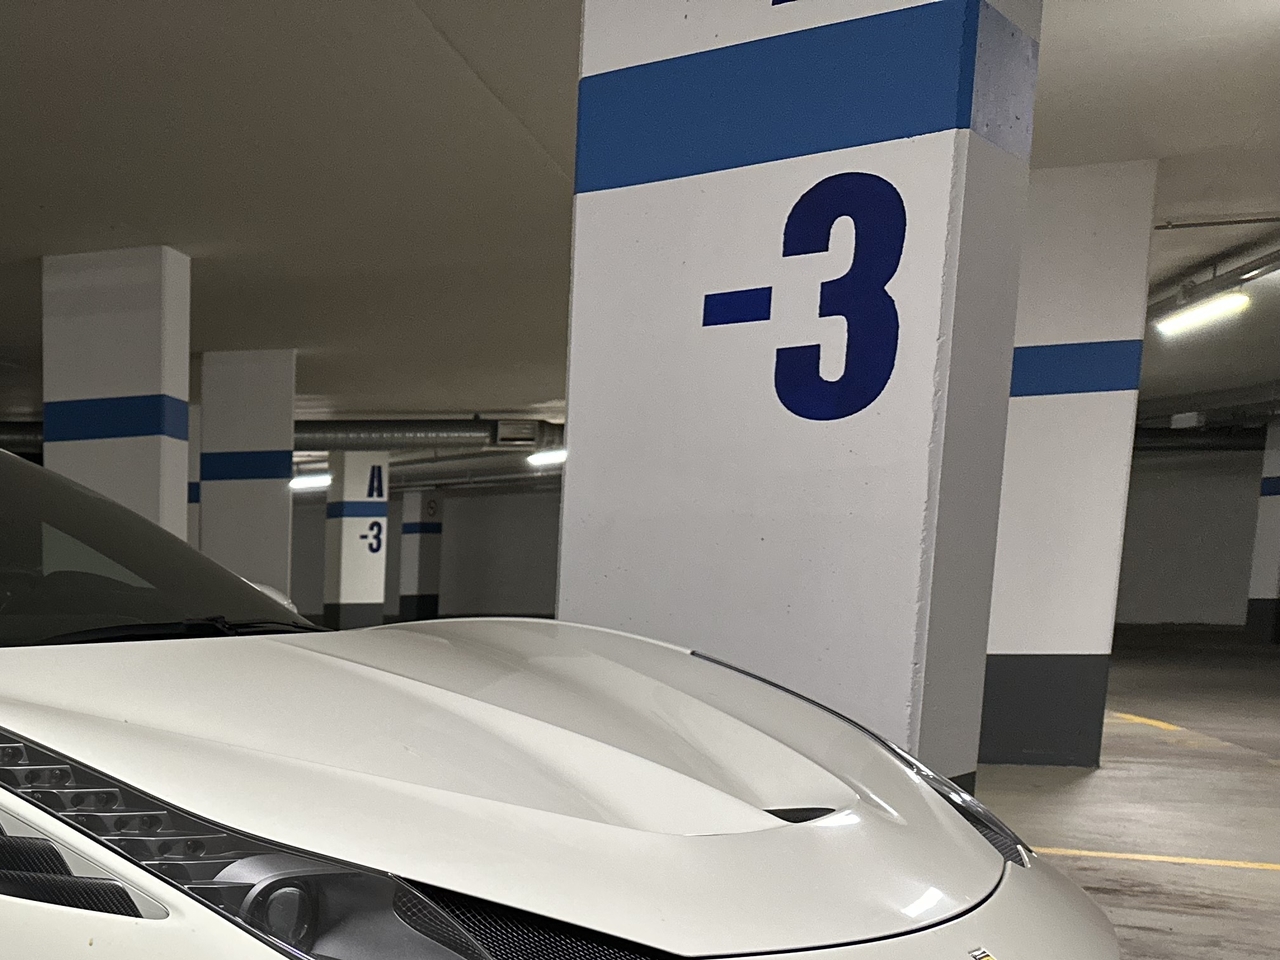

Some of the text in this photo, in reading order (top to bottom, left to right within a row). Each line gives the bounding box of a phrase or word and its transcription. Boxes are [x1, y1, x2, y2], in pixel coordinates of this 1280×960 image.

[702, 172, 907, 421] -3
[368, 465, 383, 498] A
[360, 521, 382, 553] -3
